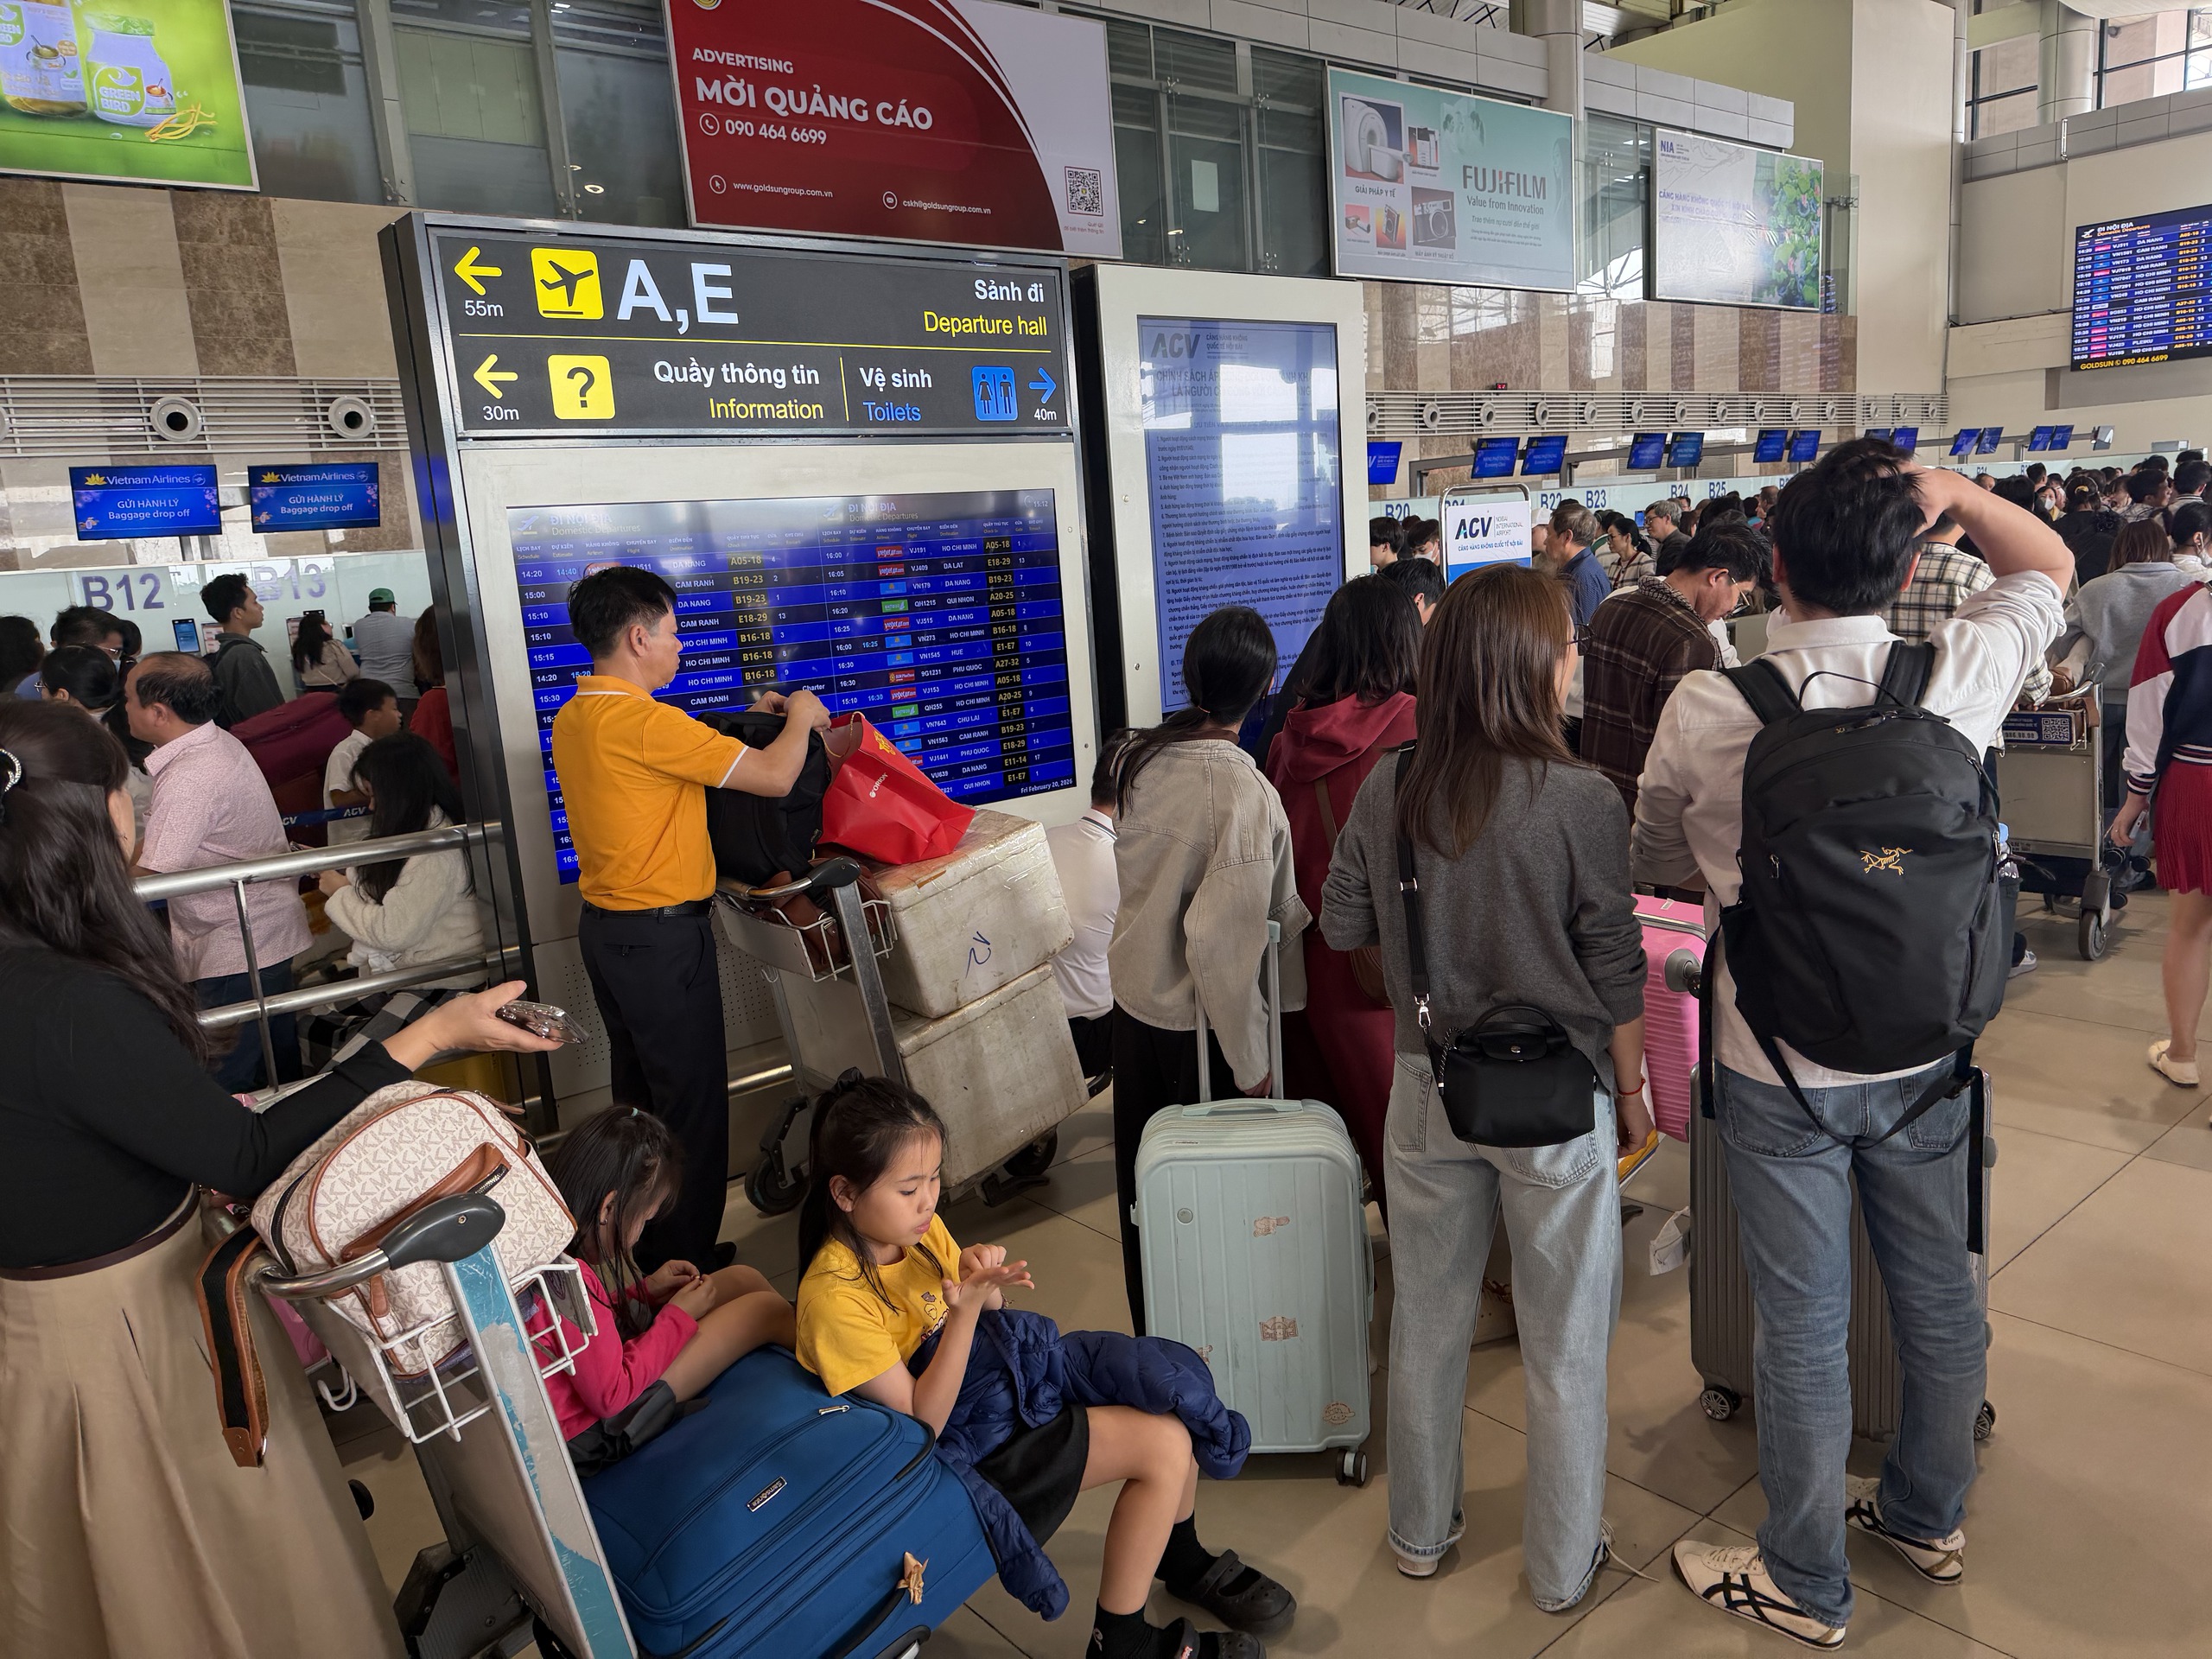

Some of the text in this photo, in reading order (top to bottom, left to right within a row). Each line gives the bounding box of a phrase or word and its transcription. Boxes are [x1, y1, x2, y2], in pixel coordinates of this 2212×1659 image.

[692, 48, 794, 73] ADVERTISING
[99, 86, 141, 101] GREEN
[696, 74, 933, 130] MỜI QUẢNG CÁO
[101, 99, 130, 112] BIRD
[725, 119, 827, 144] 090 464 6699
[1661, 140, 1675, 154] NIA
[733, 181, 833, 198] www.goldsungroup.com.vn
[1463, 165, 1546, 200] FUJIFILM
[902, 199, 991, 215] cskh@goldsungroup.com.vn
[1467, 195, 1544, 214] Value from Innovation
[464, 259, 739, 335] 55m A,E
[975, 279, 1045, 302] Sảnh đi
[924, 310, 1048, 338] Departure hall
[1151, 333, 1200, 359] ACV
[654, 357, 820, 389] Quầy thông tin
[2081, 359, 2113, 370] GOLDSUN
[859, 367, 932, 392] Vệ sinh
[1185, 371, 1206, 381] SÁCH
[482, 405, 519, 422] 30m
[709, 397, 824, 420] Information
[863, 401, 922, 422] Toilets
[1033, 408, 1057, 421] 40m
[289, 493, 344, 504] GỬI HÀNH LÝ
[1709, 481, 1726, 499] B25
[117, 498, 179, 509] GỬI HÀNH LÝ
[1586, 490, 1606, 509] B23
[108, 508, 190, 521] Baggage drop off
[281, 505, 318, 515] Baggage
[320, 505, 340, 514] drop
[882, 512, 918, 521] Departures
[552, 524, 640, 536] Domestic Departures
[1455, 517, 1492, 540] ACV
[556, 568, 577, 576] 14:40
[730, 556, 762, 566] A05-18
[988, 557, 1011, 567] E18-29
[255, 563, 327, 603] B13
[676, 580, 692, 588] CAM
[734, 575, 764, 585] B19-23
[988, 575, 1013, 583] B19-23
[81, 573, 165, 612] B12
[990, 592, 1014, 601] A20-25
[528, 612, 549, 620] 15:10
[735, 594, 766, 604] B19-23
[991, 608, 1015, 618] A05-18
[531, 613, 768, 641] 15:10 CAM RANH E18-29
[993, 625, 1016, 634] B16-18
[533, 653, 555, 662] 15:15
[741, 632, 771, 643] B16-18
[996, 642, 1015, 651] E1-E7
[537, 651, 772, 683] 14:20 B16-18
[995, 658, 1020, 668] A27-32
[539, 670, 775, 703] 15:30 B16-18
[1004, 756, 1027, 766] E11-14
[873, 772, 888, 792] ORION
[1029, 783, 1051, 793] February
[343, 806, 366, 817] ACV
[281, 816, 298, 826] CV
